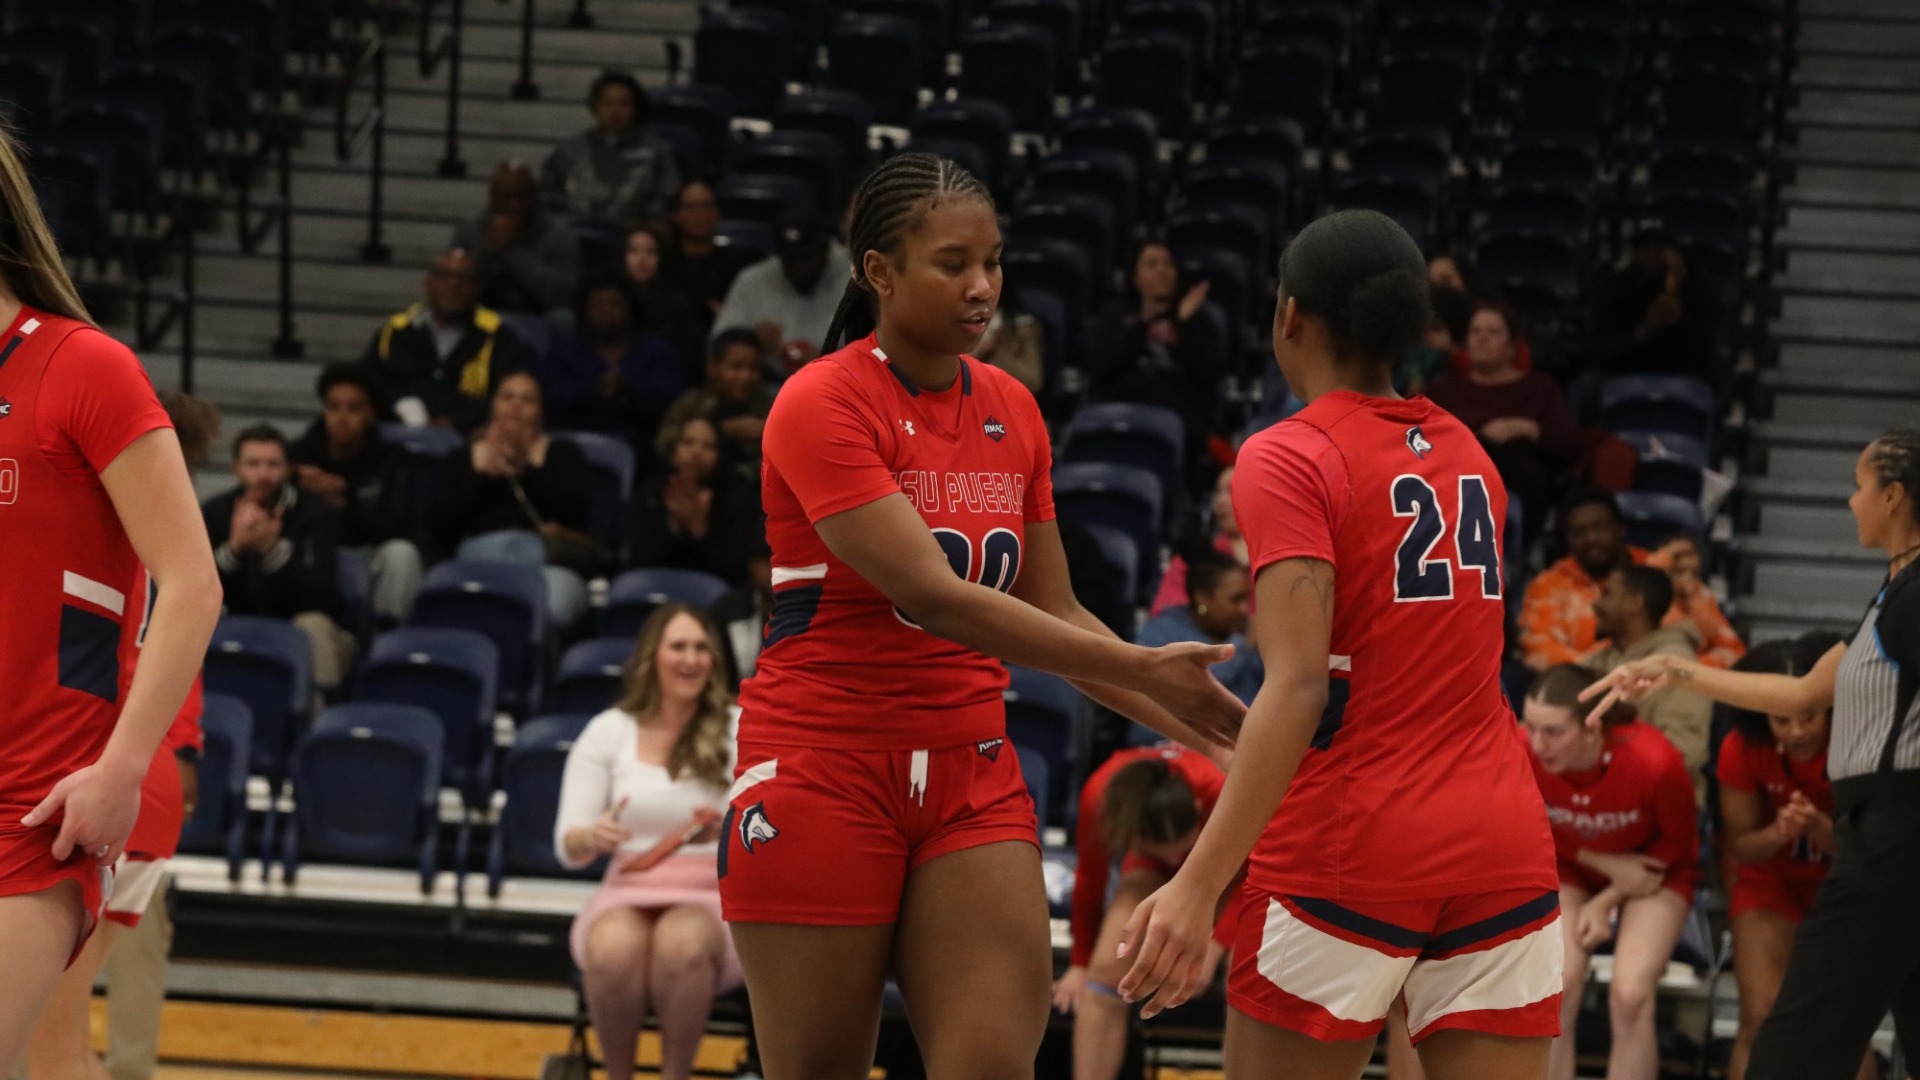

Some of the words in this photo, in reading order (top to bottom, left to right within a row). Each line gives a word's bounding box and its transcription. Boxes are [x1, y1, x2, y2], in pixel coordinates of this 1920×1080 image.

[984, 424, 1005, 434] RMAC
[892, 470, 940, 513] SU
[1390, 473, 1502, 603] 24
